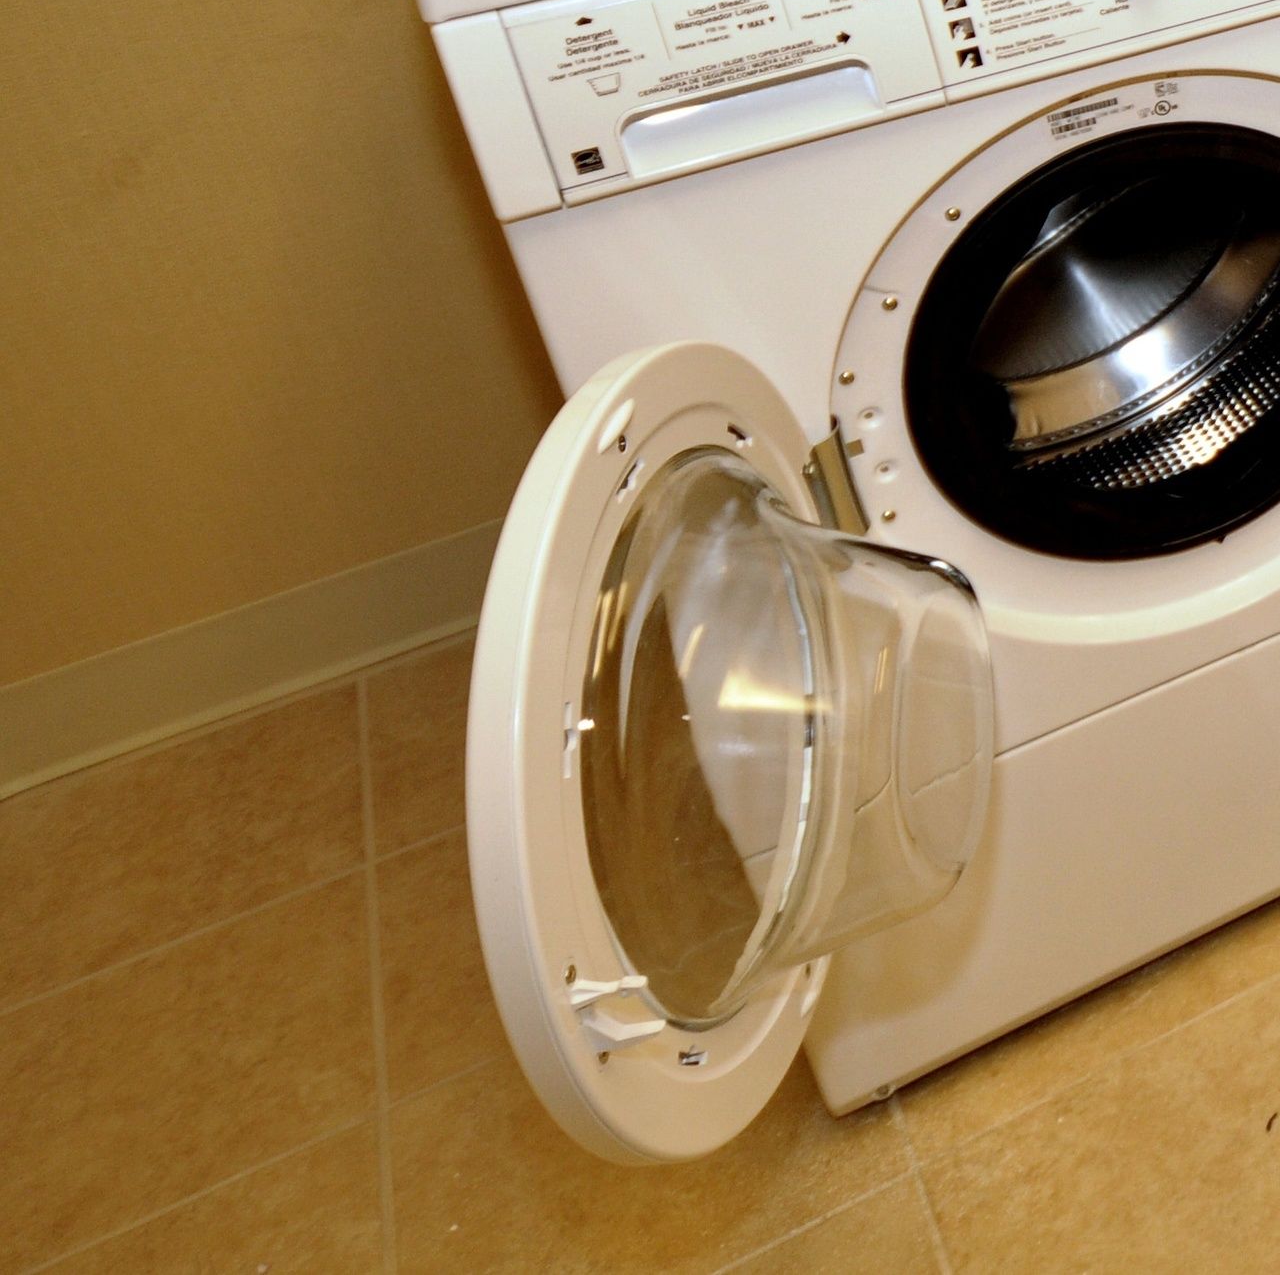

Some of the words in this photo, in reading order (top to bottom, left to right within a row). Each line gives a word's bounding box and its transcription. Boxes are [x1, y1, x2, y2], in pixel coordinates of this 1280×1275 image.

[687, 5, 717, 17] Liquid
[674, 12, 733, 31] Blanqueador
[747, 19, 765, 29] MAX
[565, 29, 613, 45] Detergent
[566, 39, 619, 56] Detergente
[659, 71, 689, 83] SAFETY
[691, 64, 717, 76] LATCH
[758, 49, 780, 60] OPEN
[781, 40, 814, 53] DRAWER
[638, 81, 688, 98] CERRADURA
[689, 78, 700, 86] DE
[701, 66, 746, 82] SEGURIDAD
[791, 43, 837, 59] CERRADURA
